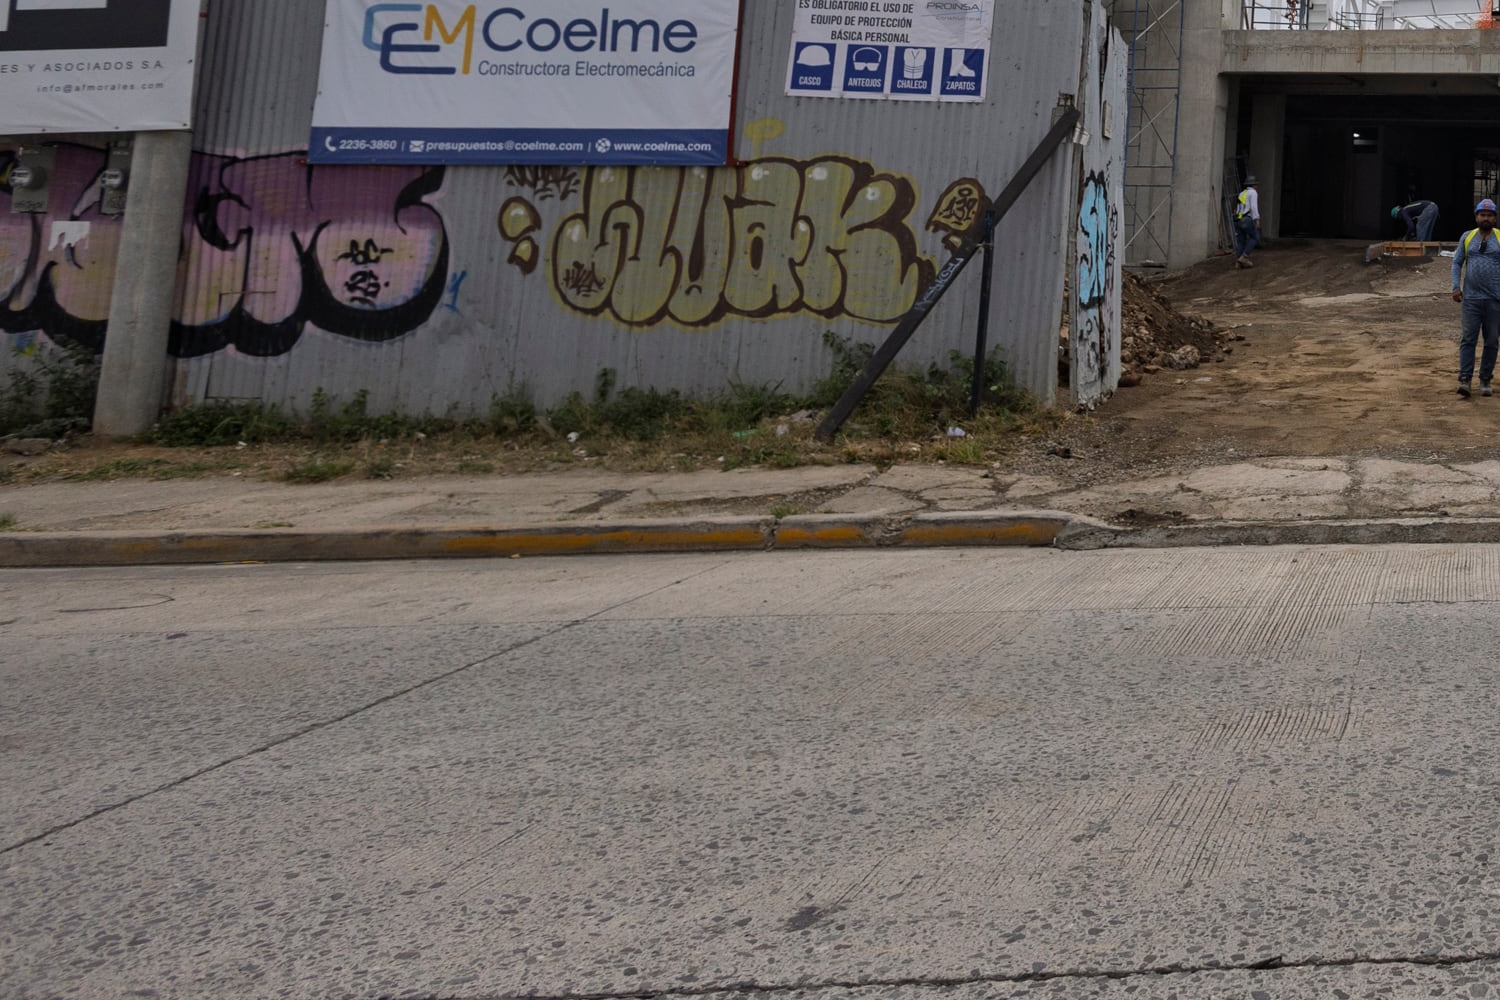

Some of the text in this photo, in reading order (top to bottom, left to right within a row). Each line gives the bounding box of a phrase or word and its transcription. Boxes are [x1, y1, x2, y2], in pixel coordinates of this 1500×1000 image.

[799, 0, 914, 14] ES OBLIGATORIO EL USO DE
[926, 2, 980, 11] PROINSA
[811, 15, 912, 28] EQUIPO DE PROTECCIÓN
[482, 7, 698, 53] Coelme
[831, 30, 910, 43] BÁSICA PERSONAL
[28, 64, 36, 72] Y
[43, 61, 134, 72] ASOCIADOS
[478, 60, 695, 77] Constructora Electromecánica
[799, 76, 821, 86] CASCO
[848, 78, 881, 88] ANTEOJOS
[897, 80, 927, 89] CHALECO
[945, 81, 975, 90] ZAPATOS
[339, 139, 711, 153] 2236-3860 presupuestos@coelme.com www.coelme.com
